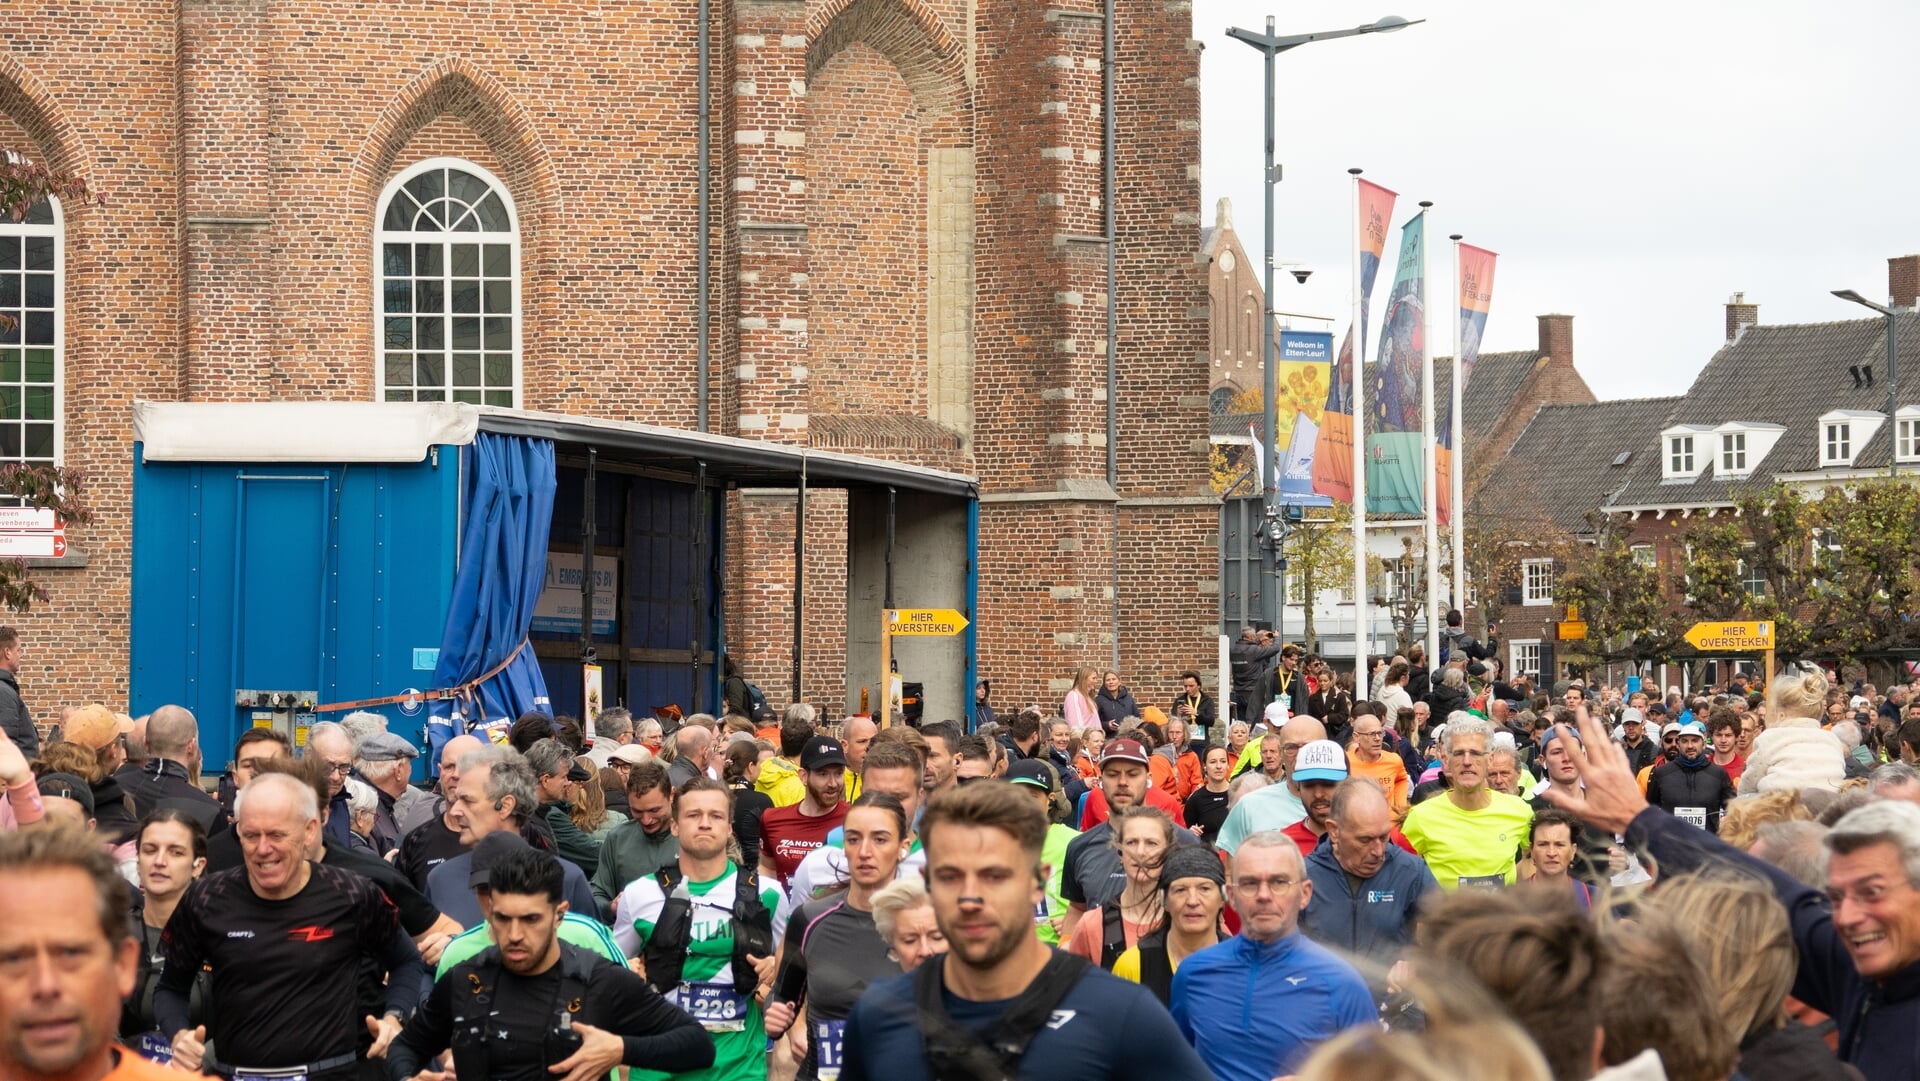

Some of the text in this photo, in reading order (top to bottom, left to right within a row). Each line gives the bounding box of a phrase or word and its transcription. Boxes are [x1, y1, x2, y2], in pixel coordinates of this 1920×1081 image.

[1287, 341, 1316, 349] Welkom
[1285, 349, 1325, 357] Etten-Leur!
[0, 519, 40, 527] venbergen
[559, 567, 602, 587] EMBRTS
[911, 613, 933, 622] HIER
[890, 623, 955, 633] OVERSTEKEN
[1722, 626, 1746, 636] HIER
[1700, 637, 1769, 648] OVERSTEKEN
[1305, 753, 1333, 765] EARTH
[780, 839, 823, 848] ZANDVO
[700, 988, 720, 997] JORY
[155, 1045, 173, 1056] CARL
